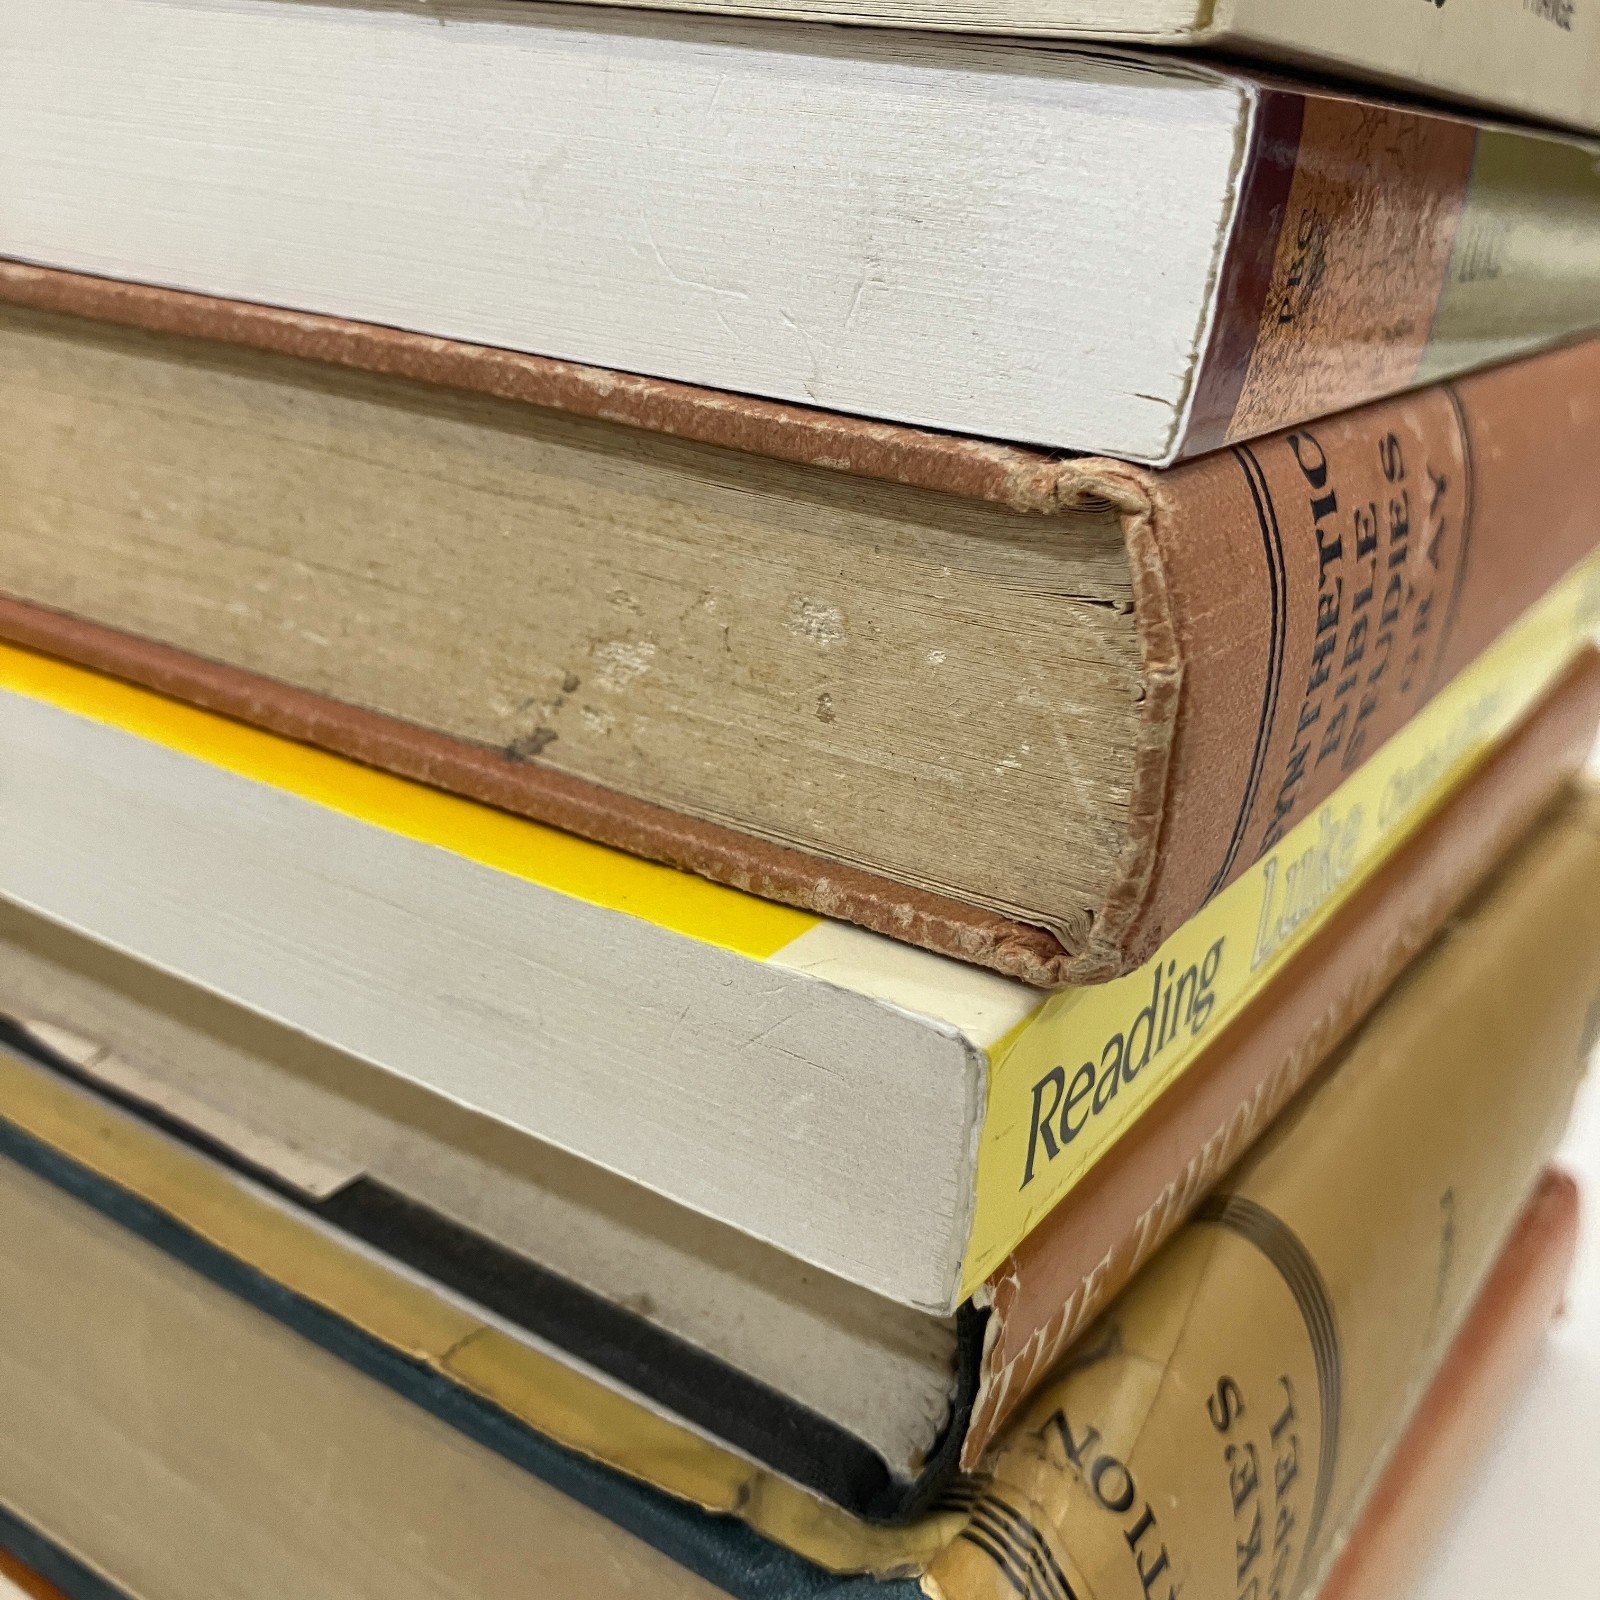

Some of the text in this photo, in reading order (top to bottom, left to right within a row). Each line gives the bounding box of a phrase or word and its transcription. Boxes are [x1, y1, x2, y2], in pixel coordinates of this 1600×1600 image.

[1314, 502, 1378, 769] BIBLE
[1341, 432, 1409, 770] STUDIES
[1018, 803, 1364, 1191] Reading Luke
[1027, 1407, 1182, 1600] TION
